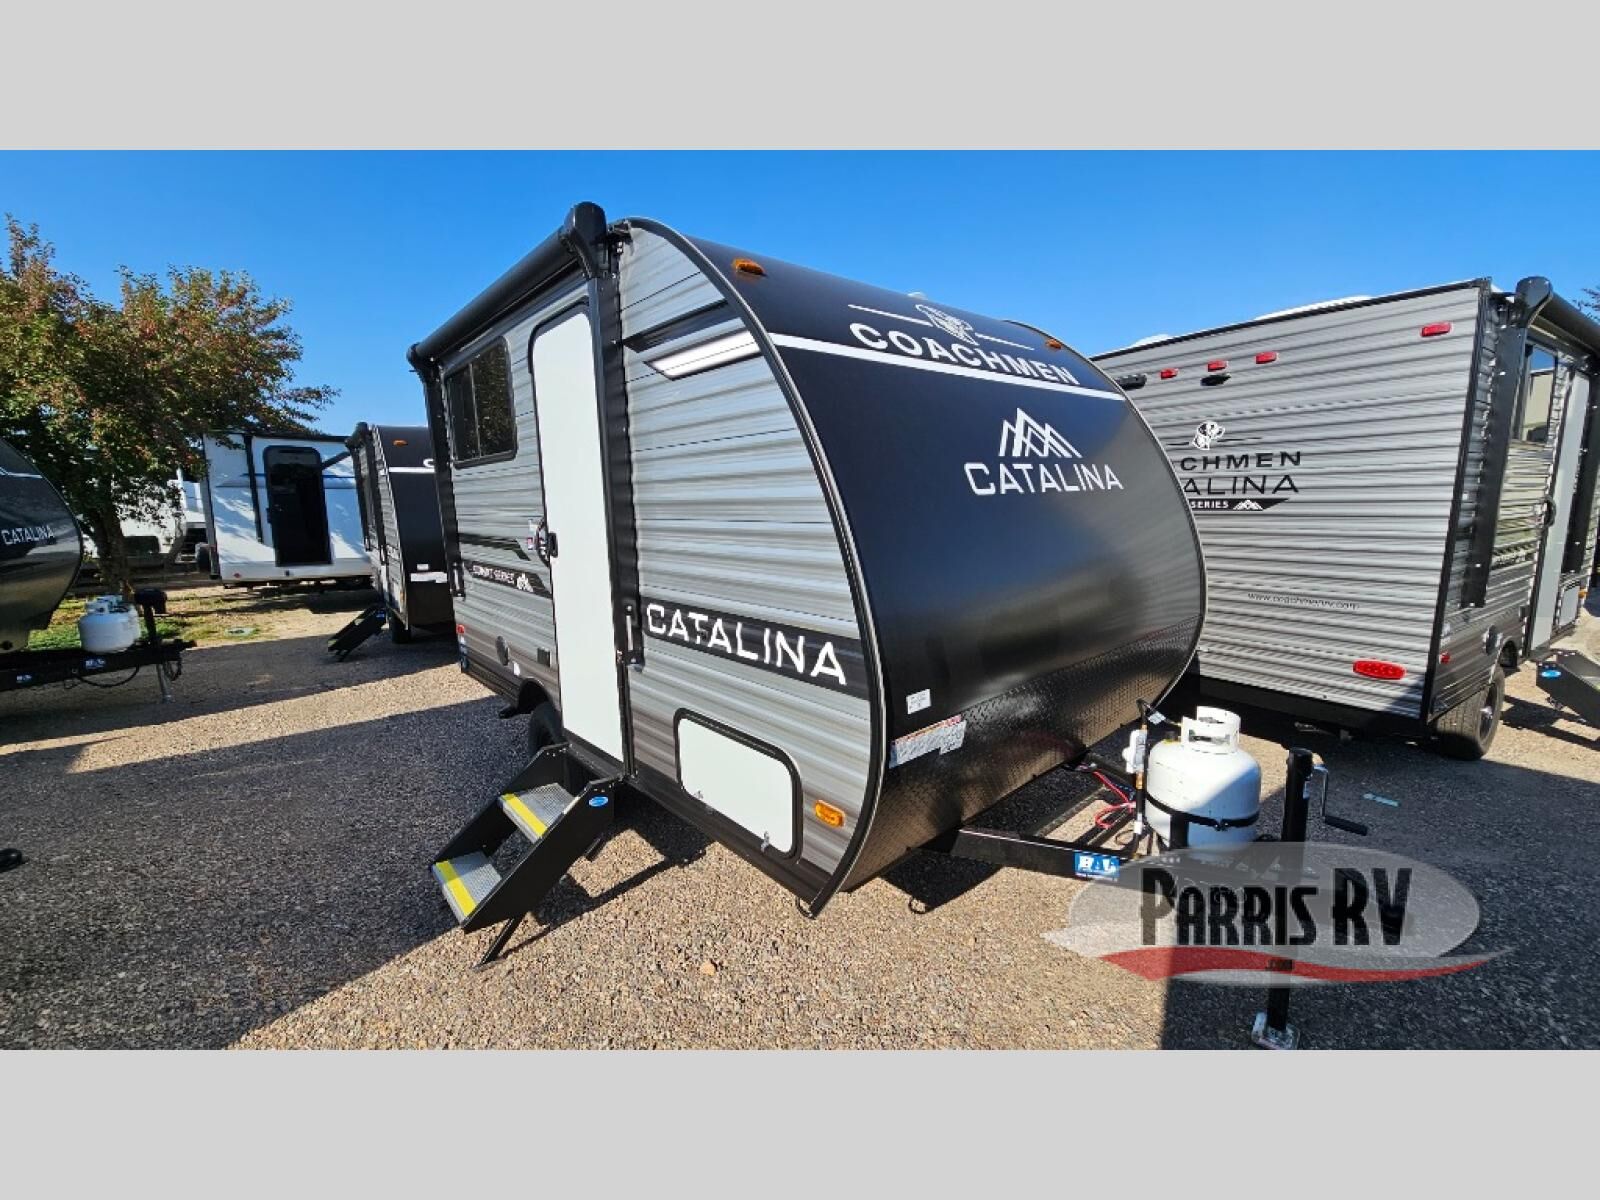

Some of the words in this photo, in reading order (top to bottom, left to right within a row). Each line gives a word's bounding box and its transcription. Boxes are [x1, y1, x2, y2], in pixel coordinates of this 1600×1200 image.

[849, 322, 1081, 386] COACHMEN
[1180, 450, 1301, 471] CHMEN
[963, 462, 1125, 496] CATALINA
[1182, 474, 1299, 496] ALINA
[1189, 500, 1230, 510] SERIES
[1, 526, 55, 546] CATALINA
[645, 602, 848, 686] CATALINA
